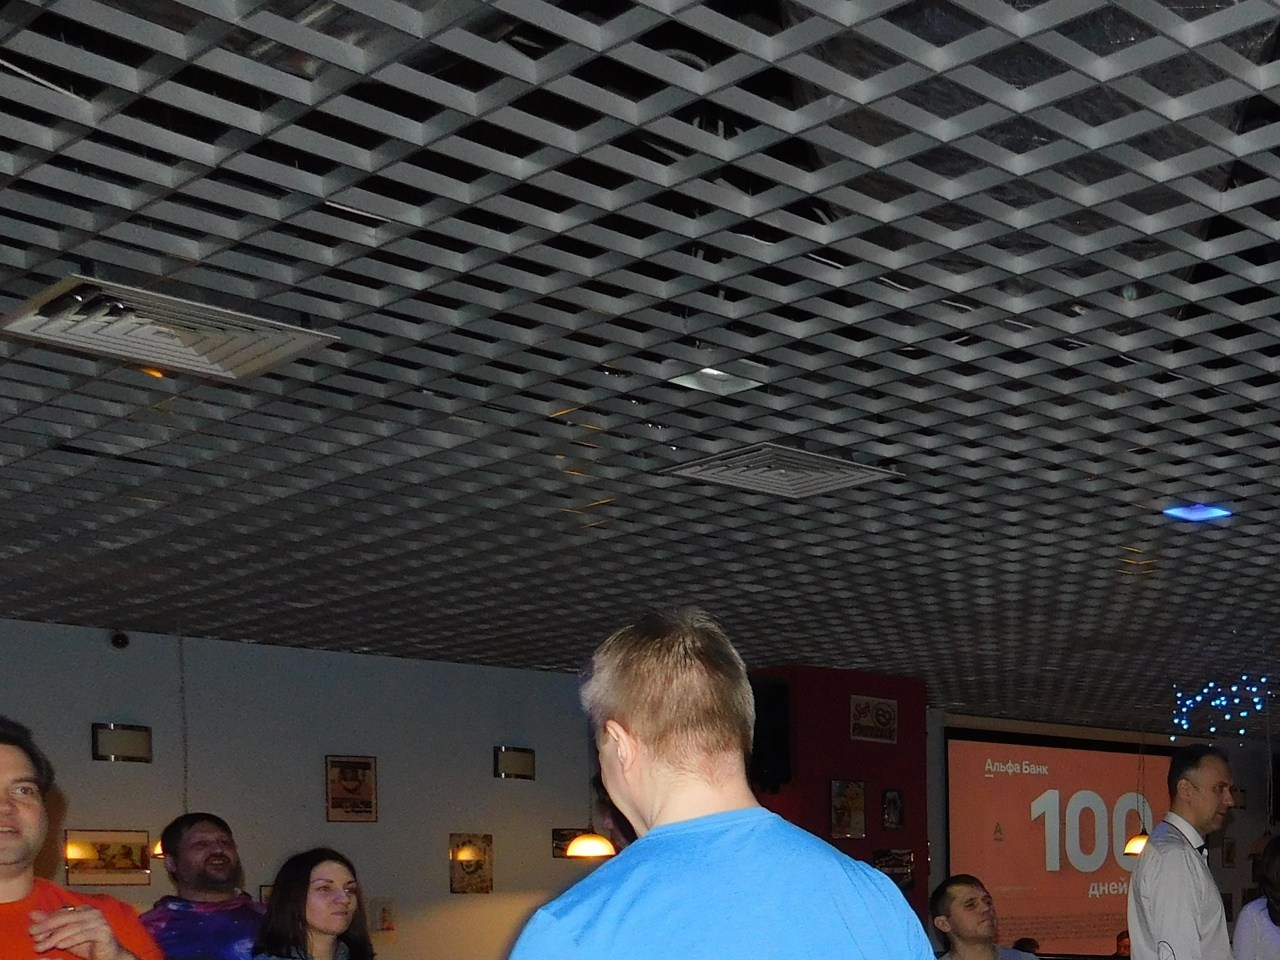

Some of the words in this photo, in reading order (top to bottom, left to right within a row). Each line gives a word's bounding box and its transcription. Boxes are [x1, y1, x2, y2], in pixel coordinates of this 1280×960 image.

[985, 758, 1020, 776] Альфа
[1022, 760, 1048, 775] Банк
[1030, 789, 1152, 873] 100
[1088, 876, 1129, 898] дней
